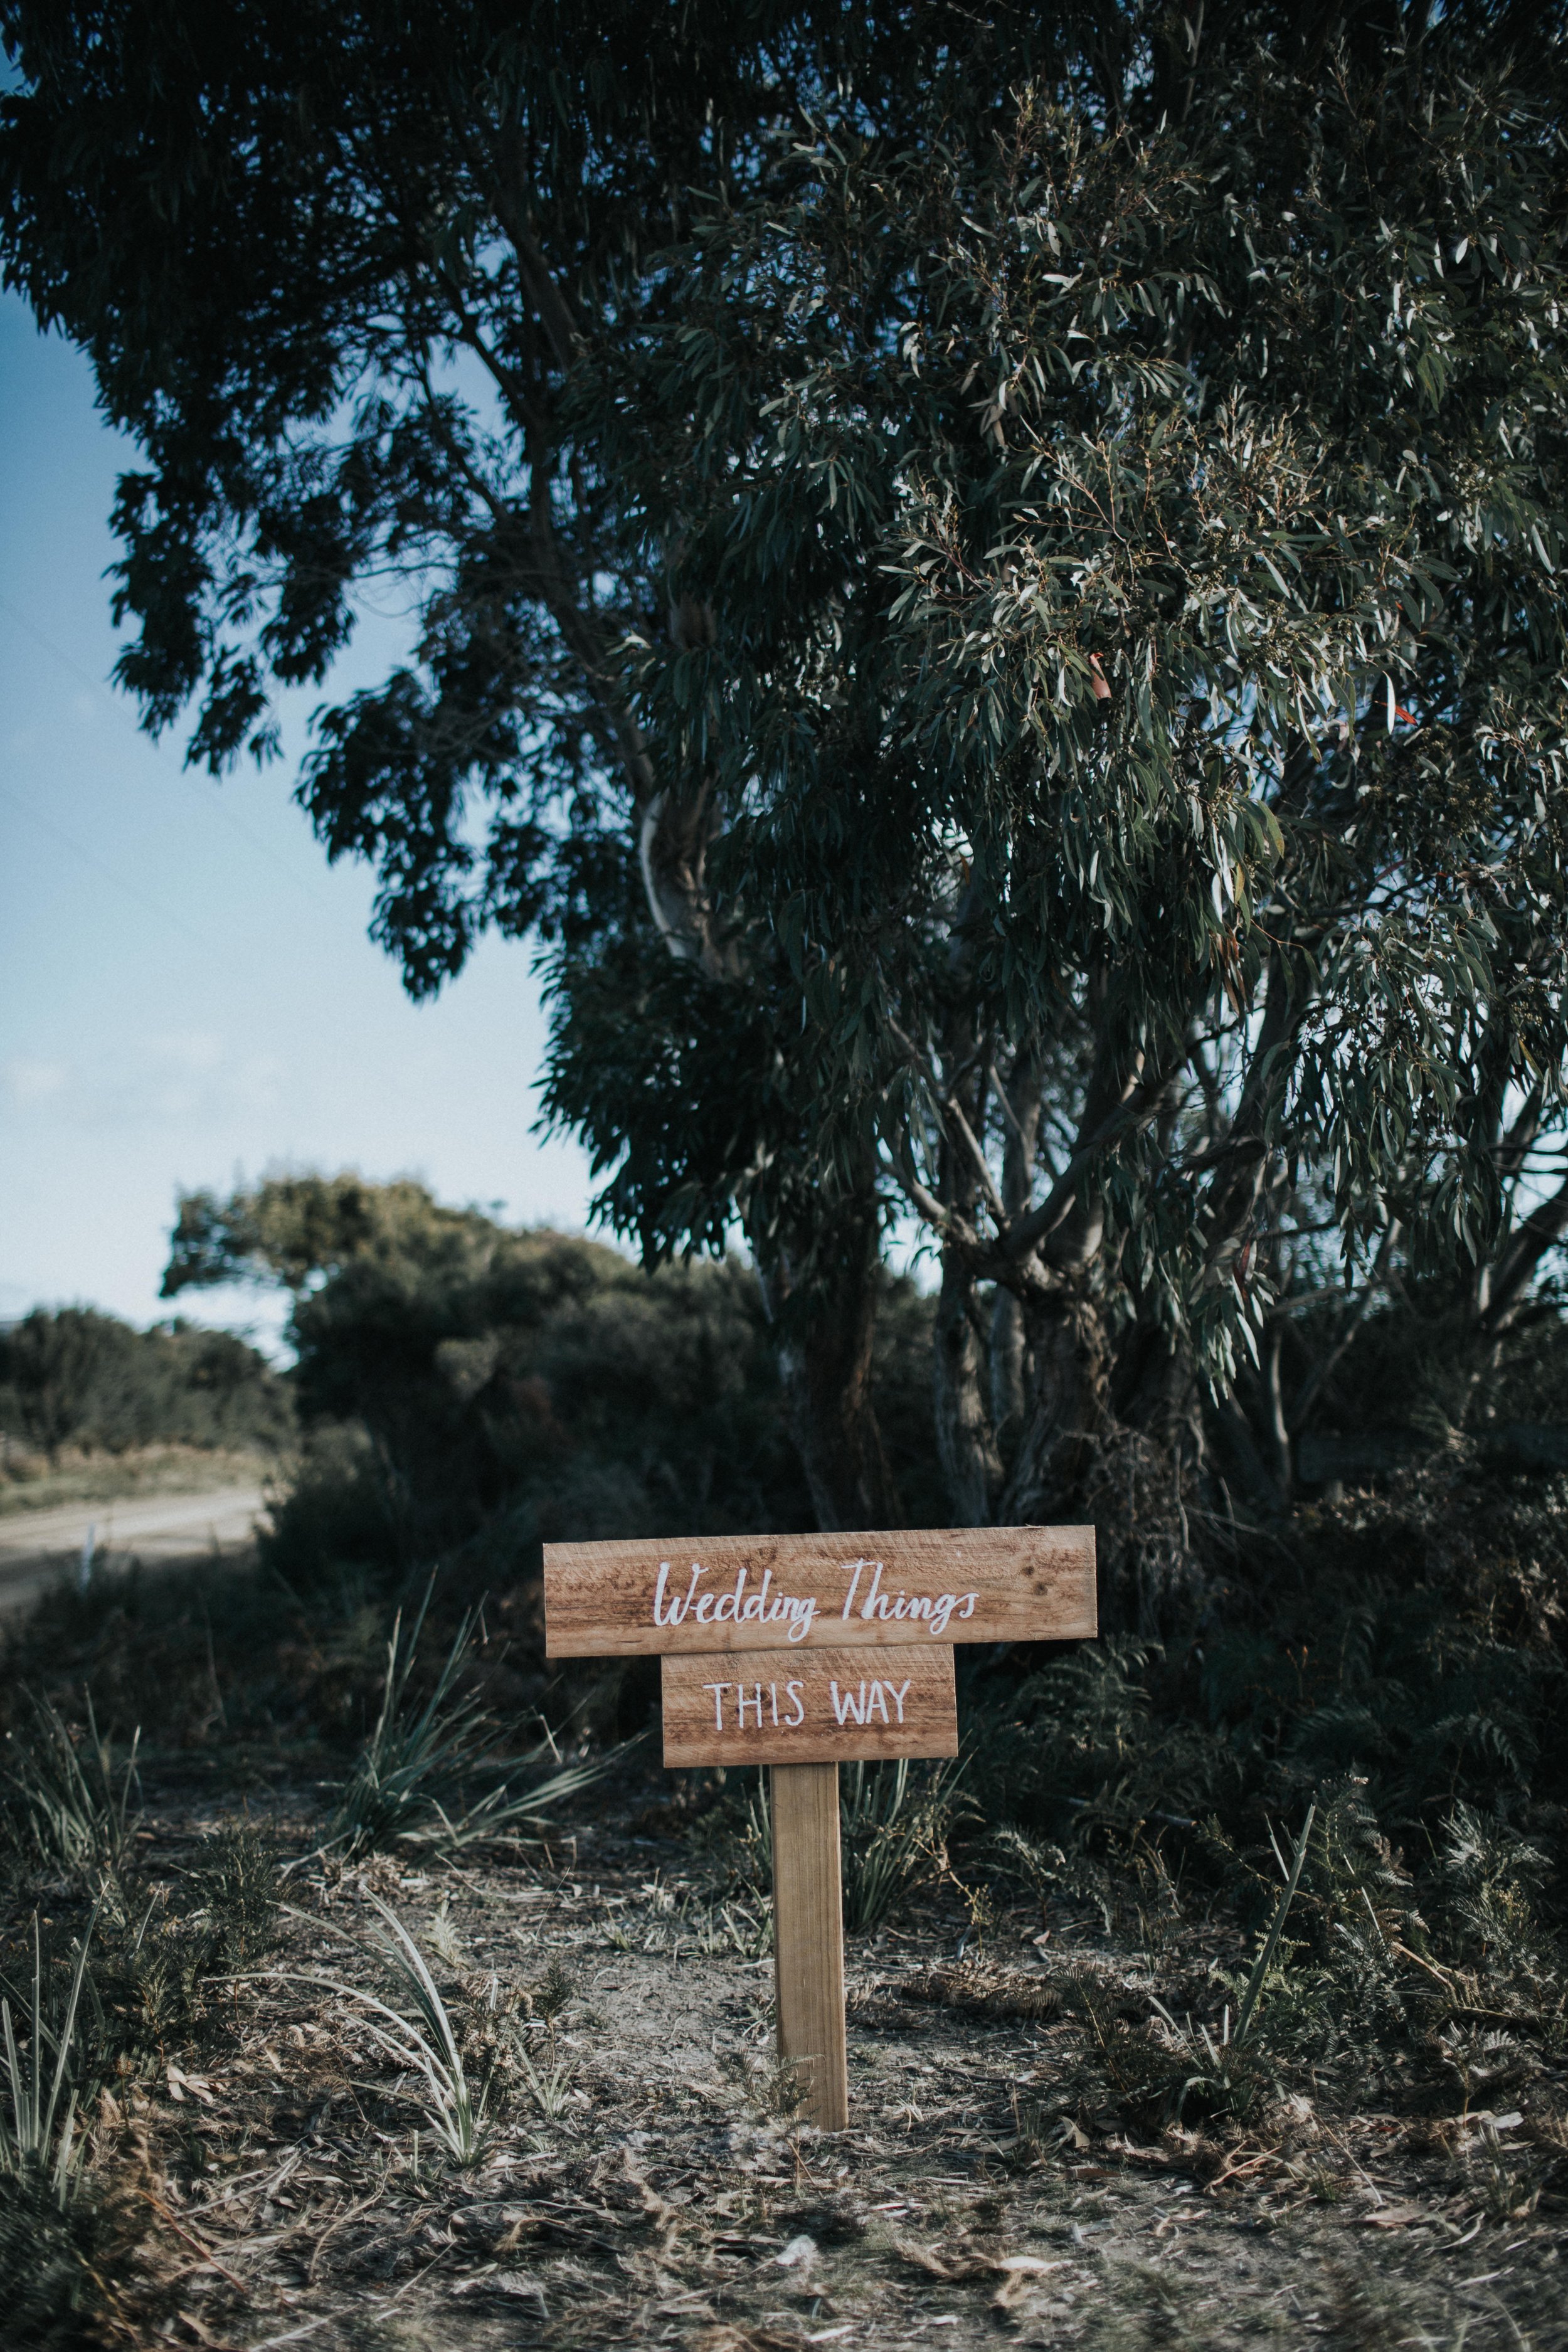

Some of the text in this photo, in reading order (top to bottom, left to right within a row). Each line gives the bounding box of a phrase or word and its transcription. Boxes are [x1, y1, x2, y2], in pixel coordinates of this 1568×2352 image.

[654, 1557, 980, 1643] Wedding Things
[702, 1678, 912, 1731] THIS WAY
